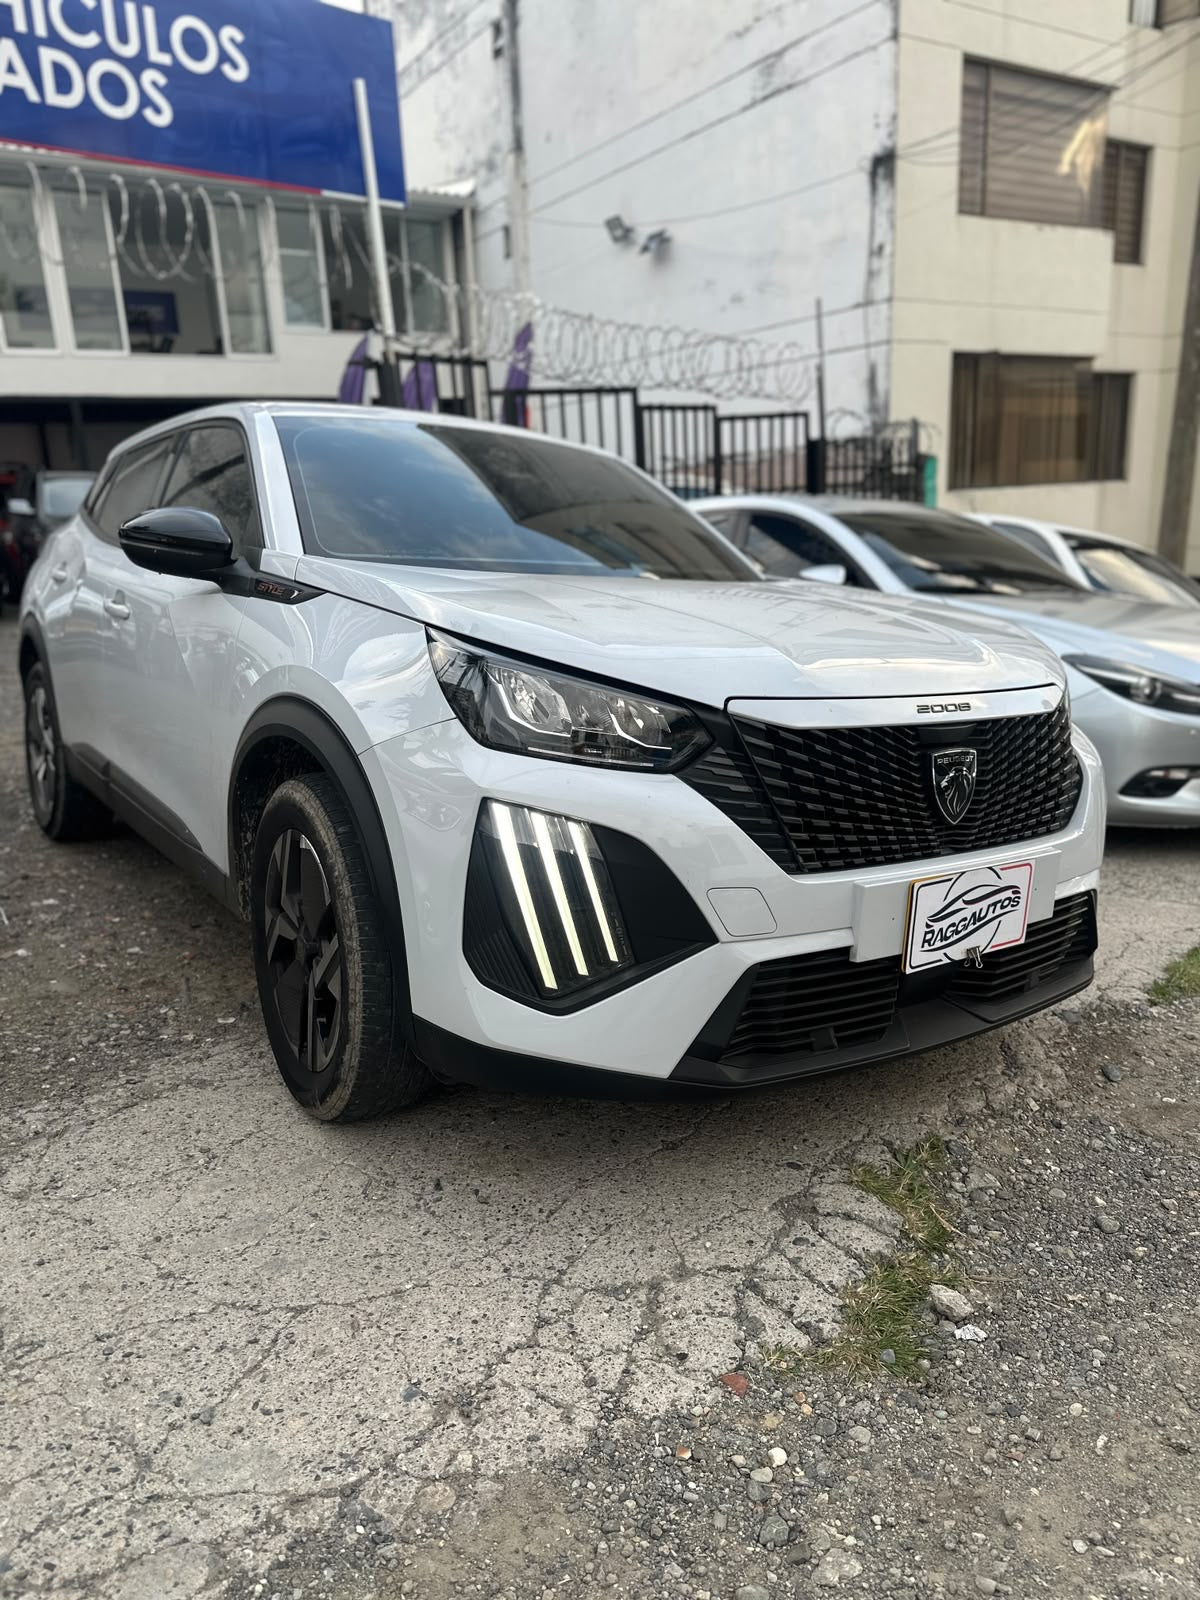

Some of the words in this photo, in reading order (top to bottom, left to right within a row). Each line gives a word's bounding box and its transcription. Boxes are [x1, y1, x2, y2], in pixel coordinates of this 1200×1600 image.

[0, 37, 174, 128] ADOS
[937, 755, 974, 765] PEUGEOT
[921, 896, 1021, 949] RAGGAUTOS
